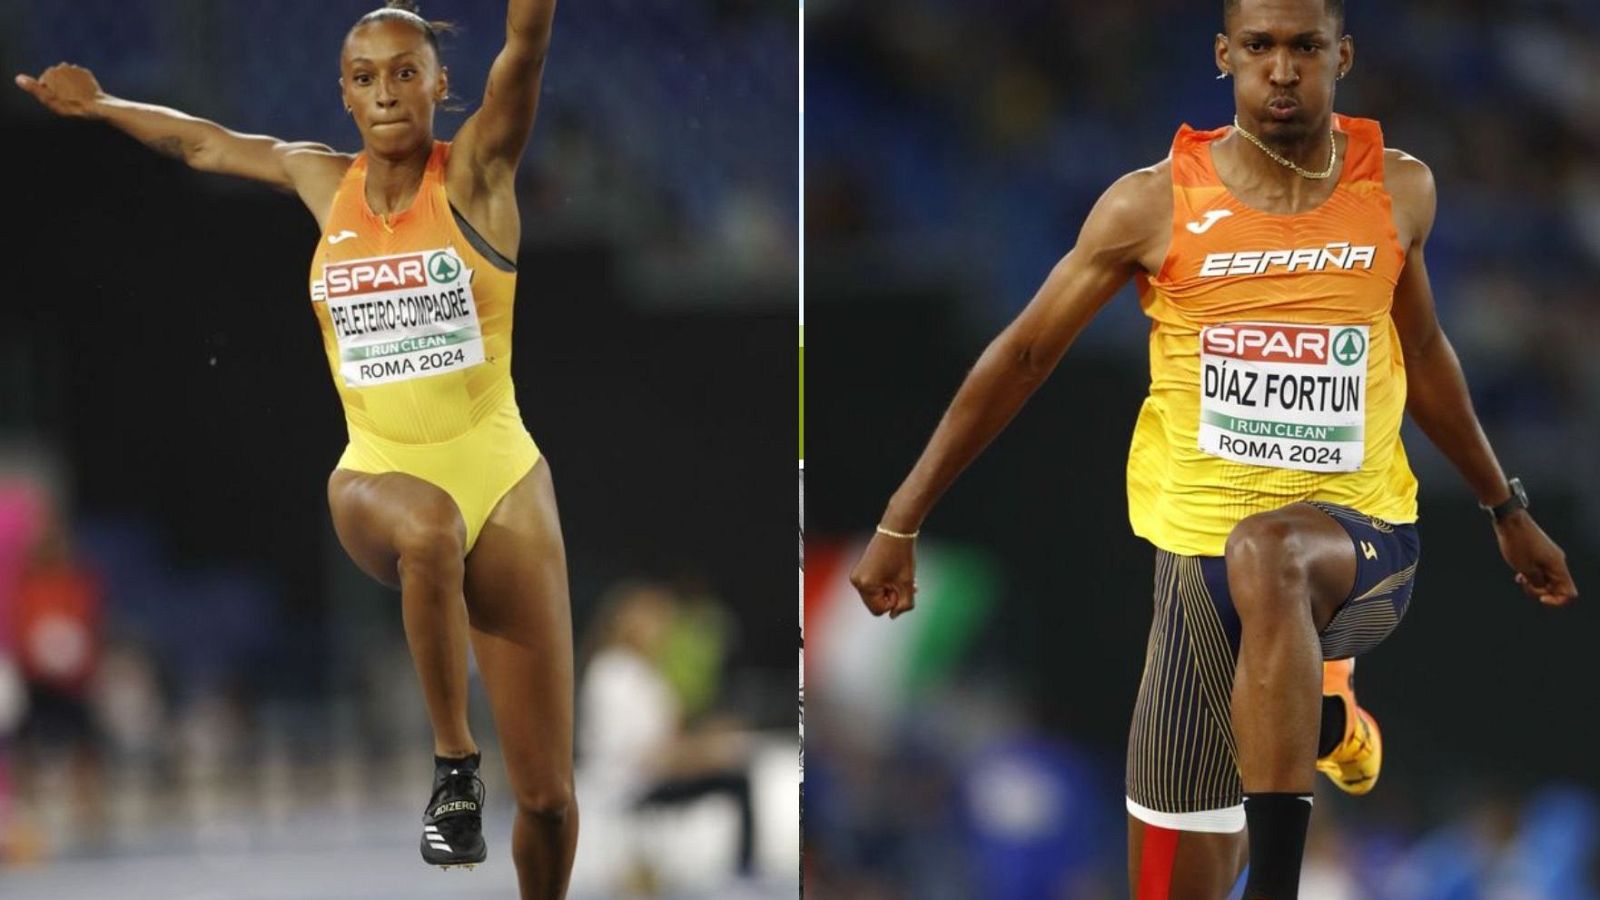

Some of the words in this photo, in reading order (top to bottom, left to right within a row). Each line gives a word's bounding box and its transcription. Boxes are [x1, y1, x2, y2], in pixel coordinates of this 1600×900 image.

[1200, 241, 1376, 277] ESPAÑA
[328, 261, 424, 293] SPAR
[331, 281, 470, 337] PELETEIRO-COMPAORÉ
[370, 342, 400, 356] RUN
[400, 334, 447, 351] CLEAN
[1206, 327, 1326, 360] SPAR
[360, 358, 415, 380] ROMA
[419, 349, 465, 371] 2024
[1205, 360, 1258, 407] DÍAZ
[1264, 374, 1360, 413] FORTUN
[1238, 419, 1271, 435] RUN
[1219, 434, 1284, 461] ROMA
[1289, 445, 1342, 465] 2024
[434, 801, 476, 817] ADIZERO
